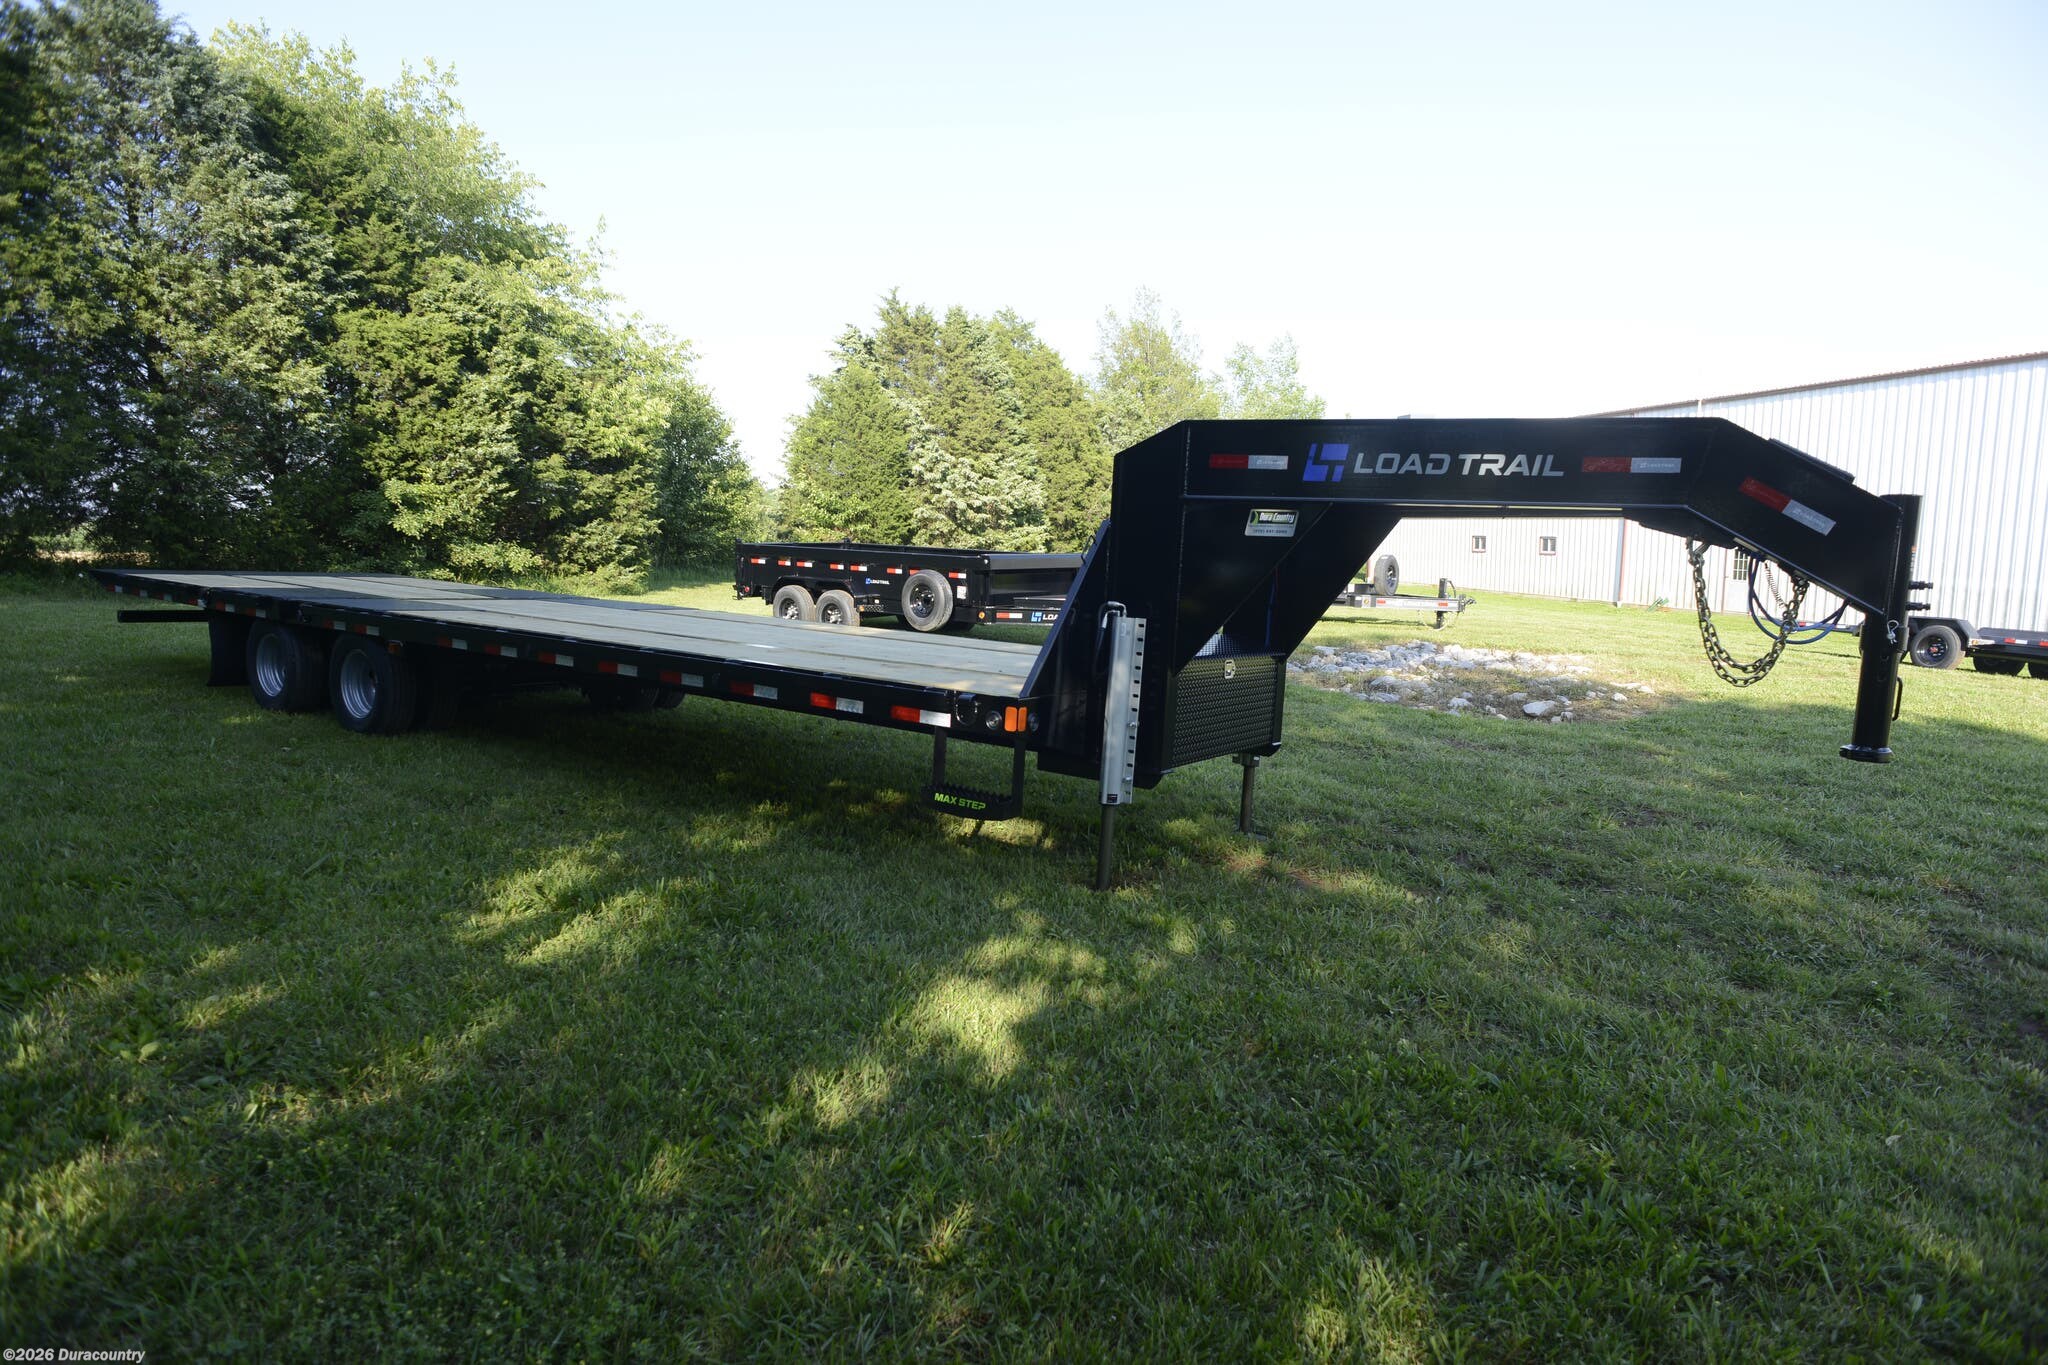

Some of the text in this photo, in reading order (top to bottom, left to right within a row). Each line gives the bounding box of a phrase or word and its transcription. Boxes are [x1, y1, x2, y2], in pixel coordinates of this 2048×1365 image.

[1353, 452, 1451, 476] LOAD
[1458, 453, 1565, 477] TRAIL
[934, 792, 987, 810] MAX STEP
